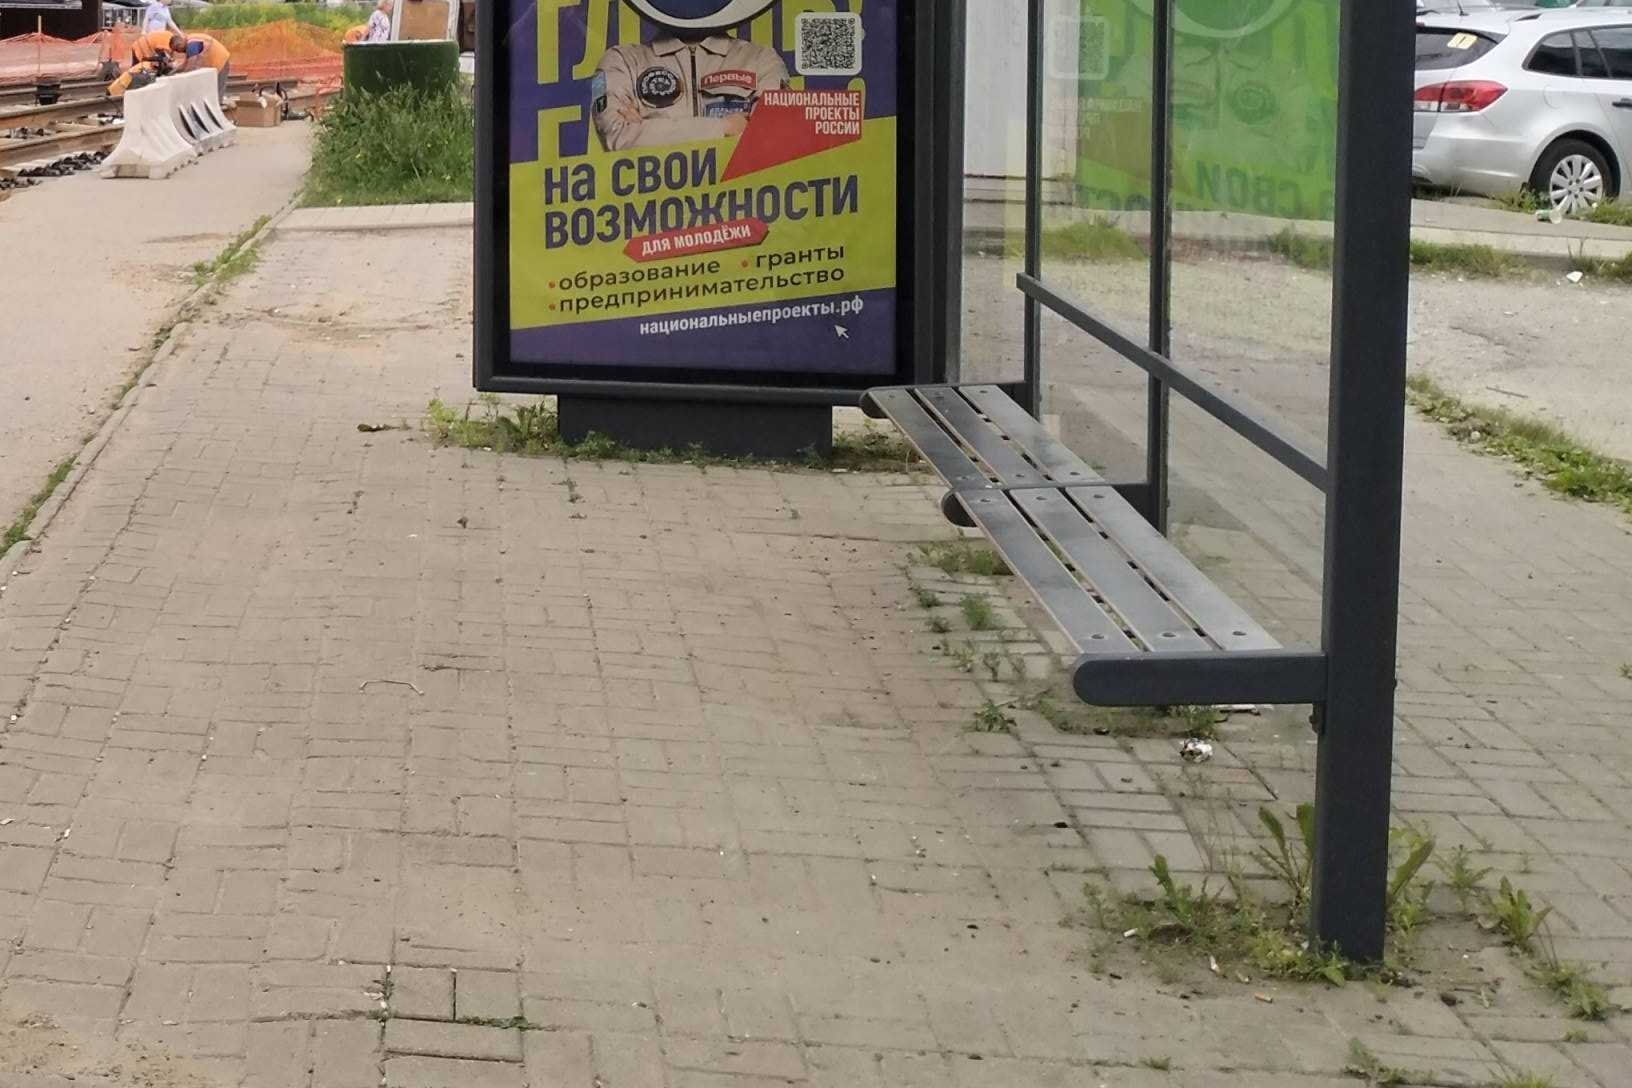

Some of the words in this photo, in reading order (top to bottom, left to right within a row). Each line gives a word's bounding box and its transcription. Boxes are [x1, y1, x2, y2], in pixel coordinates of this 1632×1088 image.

[763, 91, 860, 107] НАЦИОНАЛЬНЫЕ
[804, 106, 860, 121] ПРОЕКТЫ
[814, 120, 860, 135] РОССИИ
[611, 147, 717, 198] СВОИ
[544, 175, 859, 250] ВОЗМОЖНОСТИ
[641, 237, 671, 257] ДЛЯ
[673, 223, 752, 249] МОЛОДЁЖИ
[756, 244, 845, 270] гранты
[559, 259, 721, 292] образование
[559, 267, 846, 315] предпринимательство
[639, 293, 865, 336] национальныепроекты.рф
